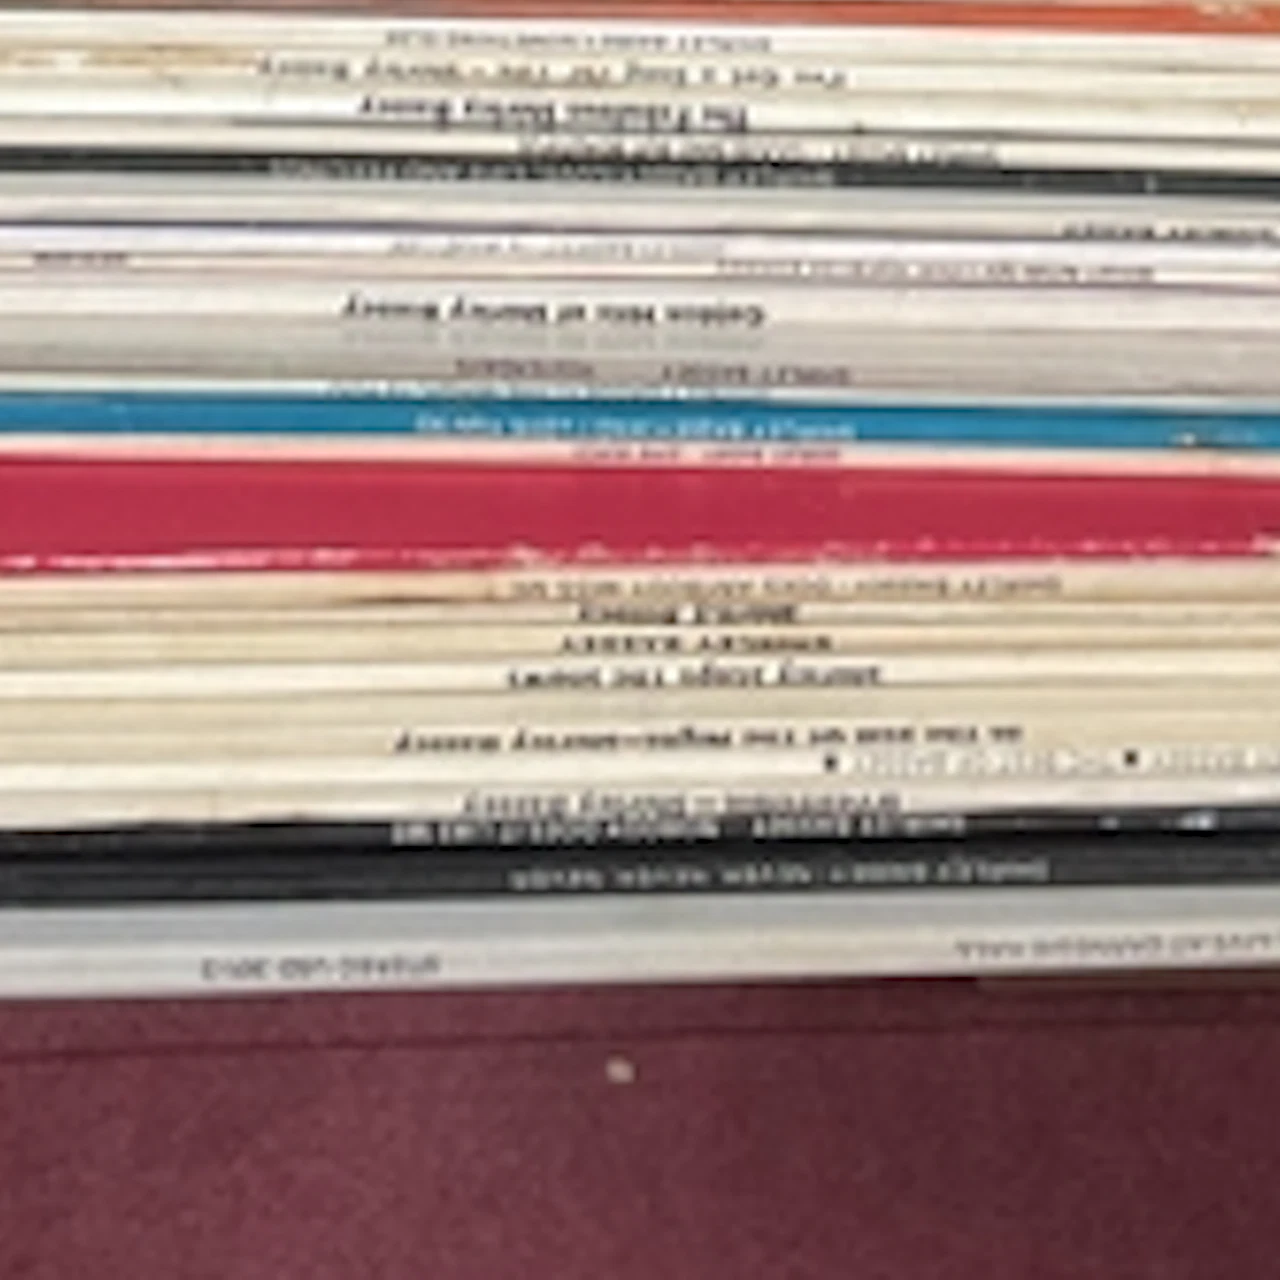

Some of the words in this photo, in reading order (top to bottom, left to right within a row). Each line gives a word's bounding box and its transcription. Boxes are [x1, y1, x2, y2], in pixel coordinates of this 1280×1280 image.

[341, 297, 439, 320] Bassey
[450, 299, 547, 323] Shirley
[555, 305, 586, 324] of
[595, 306, 656, 325] Hits
[665, 306, 764, 328] Golden
[562, 636, 684, 653] BASSEY
[699, 634, 832, 651] SHIRLEY
